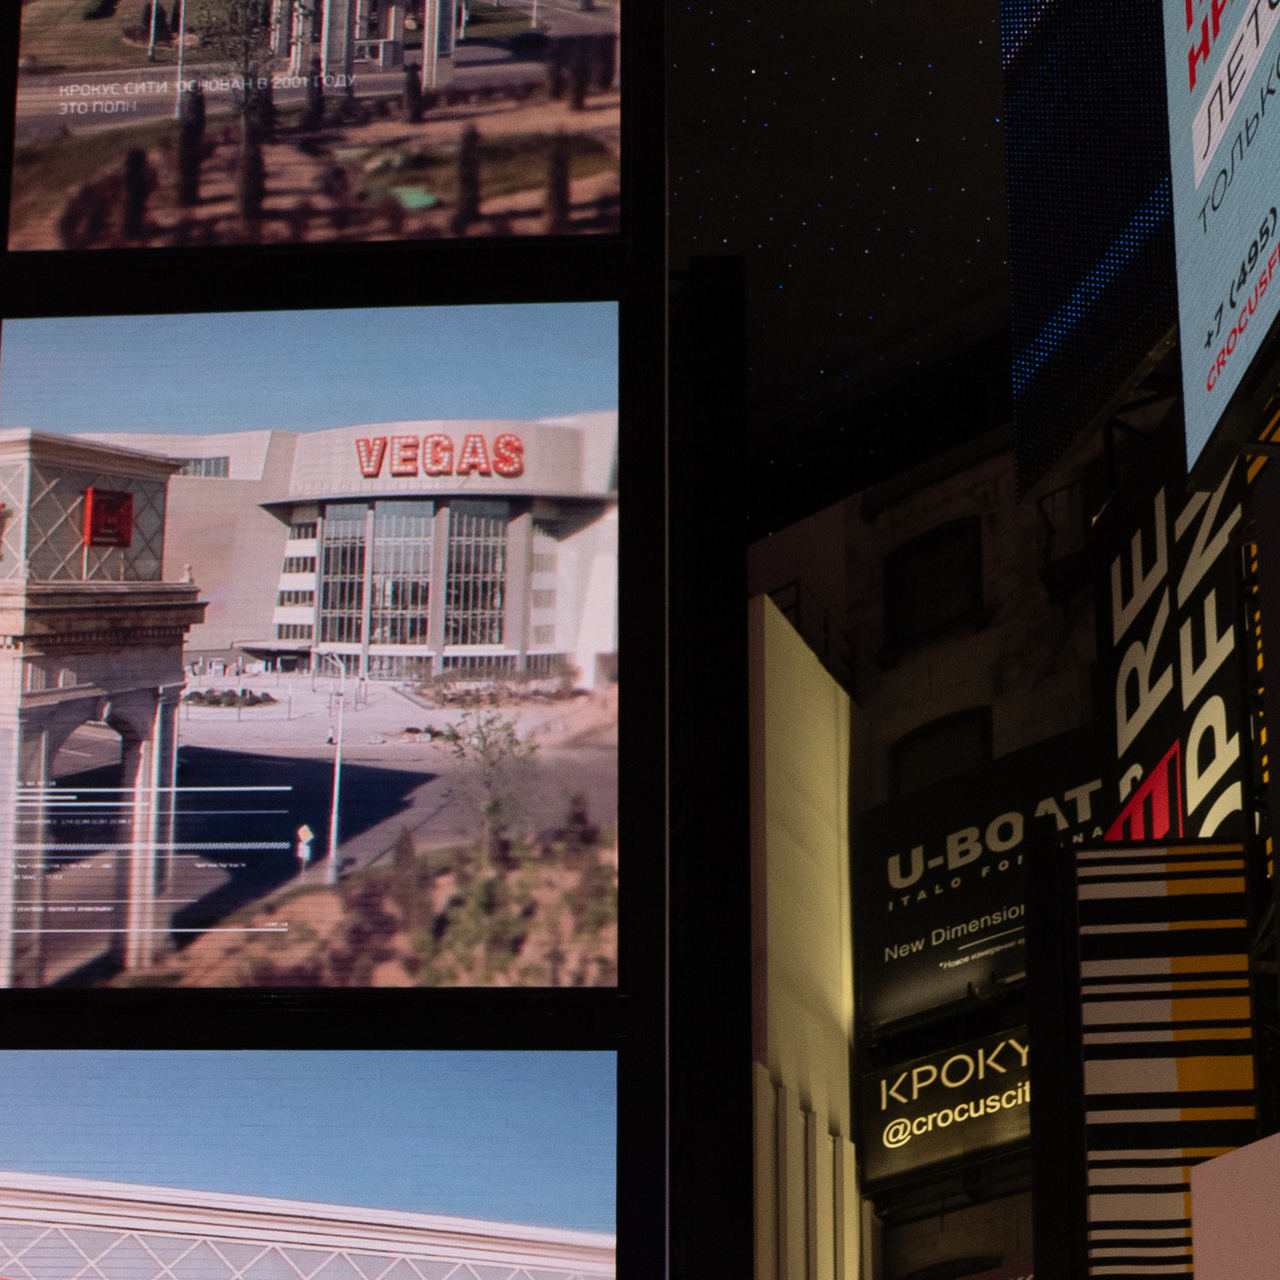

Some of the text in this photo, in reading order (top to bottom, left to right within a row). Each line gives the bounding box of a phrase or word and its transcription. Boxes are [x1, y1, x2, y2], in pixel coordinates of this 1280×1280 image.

[59, 82, 121, 97] КРОКУС
[124, 81, 168, 95] СИТИ
[177, 76, 253, 93] ОСНОВАН
[257, 77, 269, 90] В
[273, 76, 309, 89] 2001
[58, 102, 88, 115] ЭТО
[1204, 206, 1277, 350] +7 (495)
[1206, 240, 1280, 392] CROCUSF
[355, 433, 524, 478] VEGAS
[887, 779, 1102, 889] U-BOAT
[888, 877, 961, 911] ITALO
[884, 937, 925, 962] New
